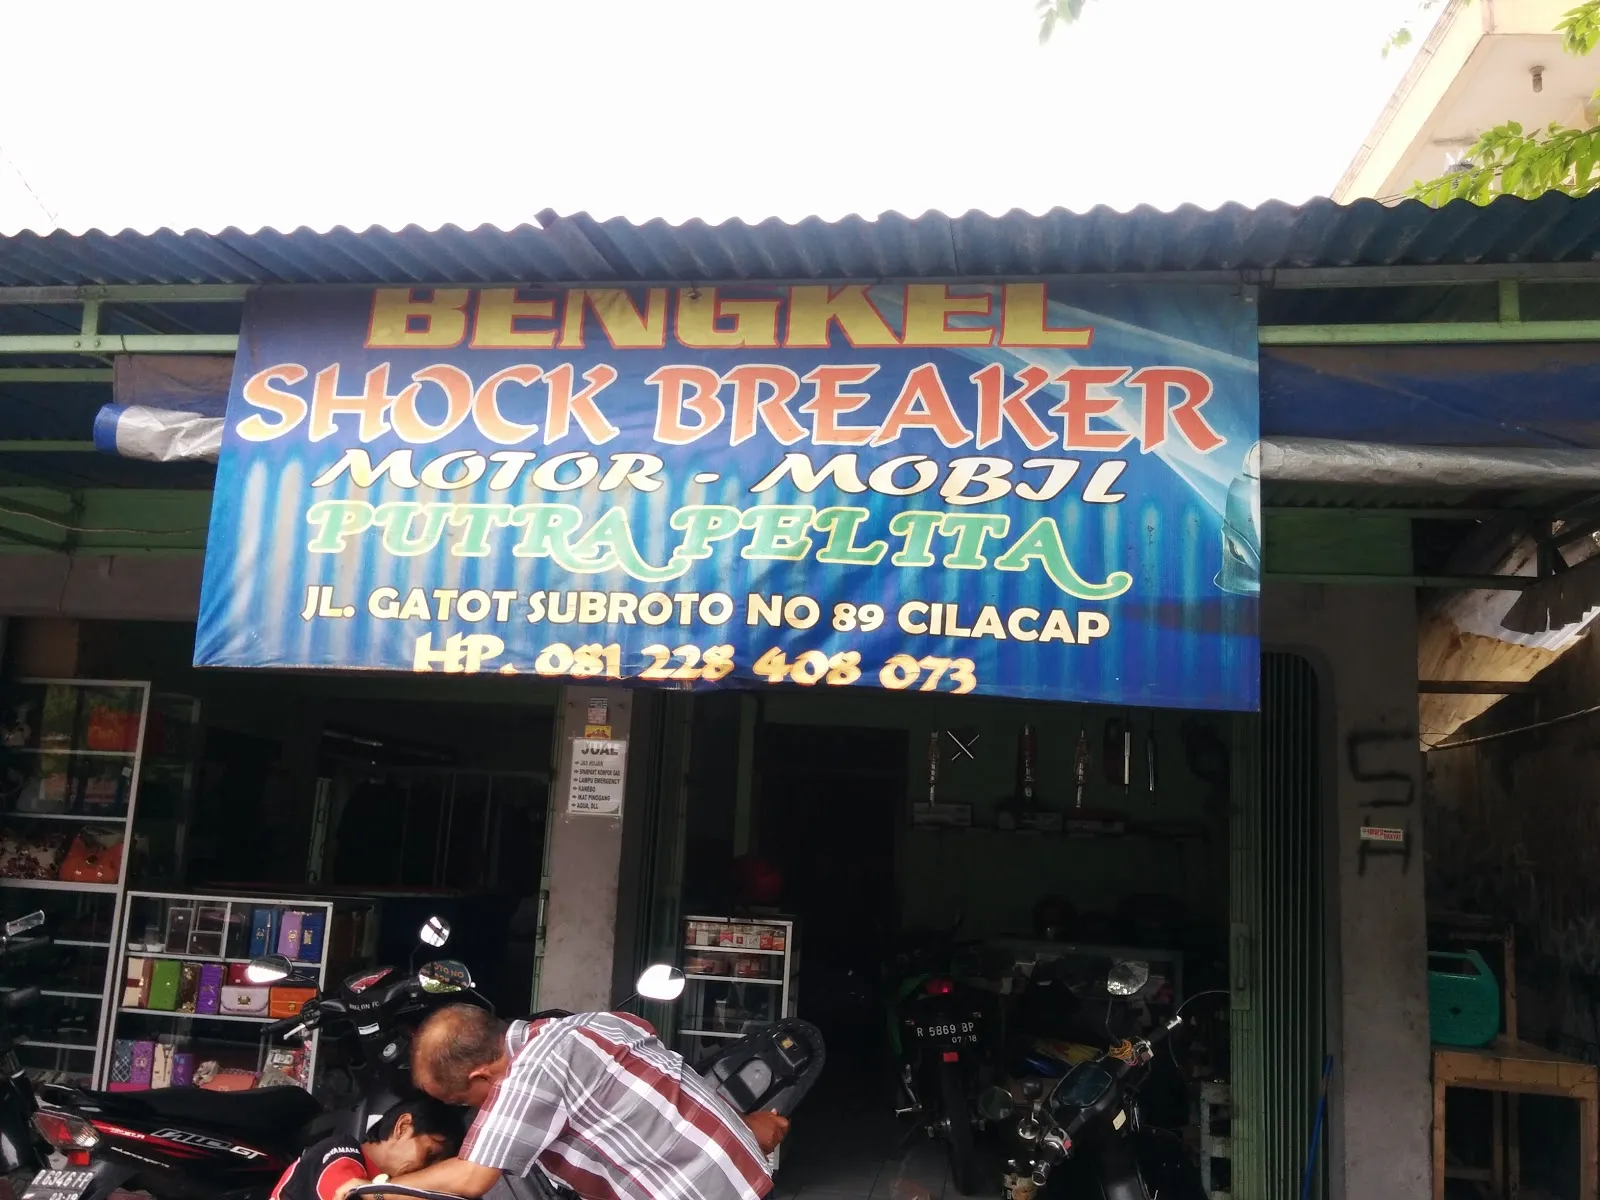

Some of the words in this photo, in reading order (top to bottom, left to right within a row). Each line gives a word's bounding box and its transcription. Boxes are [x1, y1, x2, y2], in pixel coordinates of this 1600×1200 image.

[363, 283, 1094, 349] BENGKEL
[236, 361, 620, 445] SHOCK
[644, 363, 1227, 453] BREAKER
[312, 449, 665, 492] MOTOR
[750, 453, 1128, 504] MOBIL
[306, 499, 694, 583] PUTRA
[670, 502, 1133, 600] PELITA
[301, 585, 355, 621] JL.
[367, 587, 518, 623] GATOT
[526, 590, 734, 625] SUBROTO
[746, 593, 820, 629] NO
[831, 600, 885, 633] 89
[897, 600, 1111, 646] CILACAP
[412, 631, 518, 675] HP.
[534, 643, 621, 679] 081
[638, 644, 735, 681] 228
[751, 647, 863, 685] 408
[879, 654, 977, 694] 073
[594, 777, 621, 785] EMERGENCY
[916, 1027, 924, 1037] R
[928, 1024, 957, 1037] 5869
[31, 1169, 47, 1186] R
[41, 1170, 77, 1188] 6346
[71, 1172, 94, 1188] FP
[329, 1146, 361, 1156] YAMAHA
